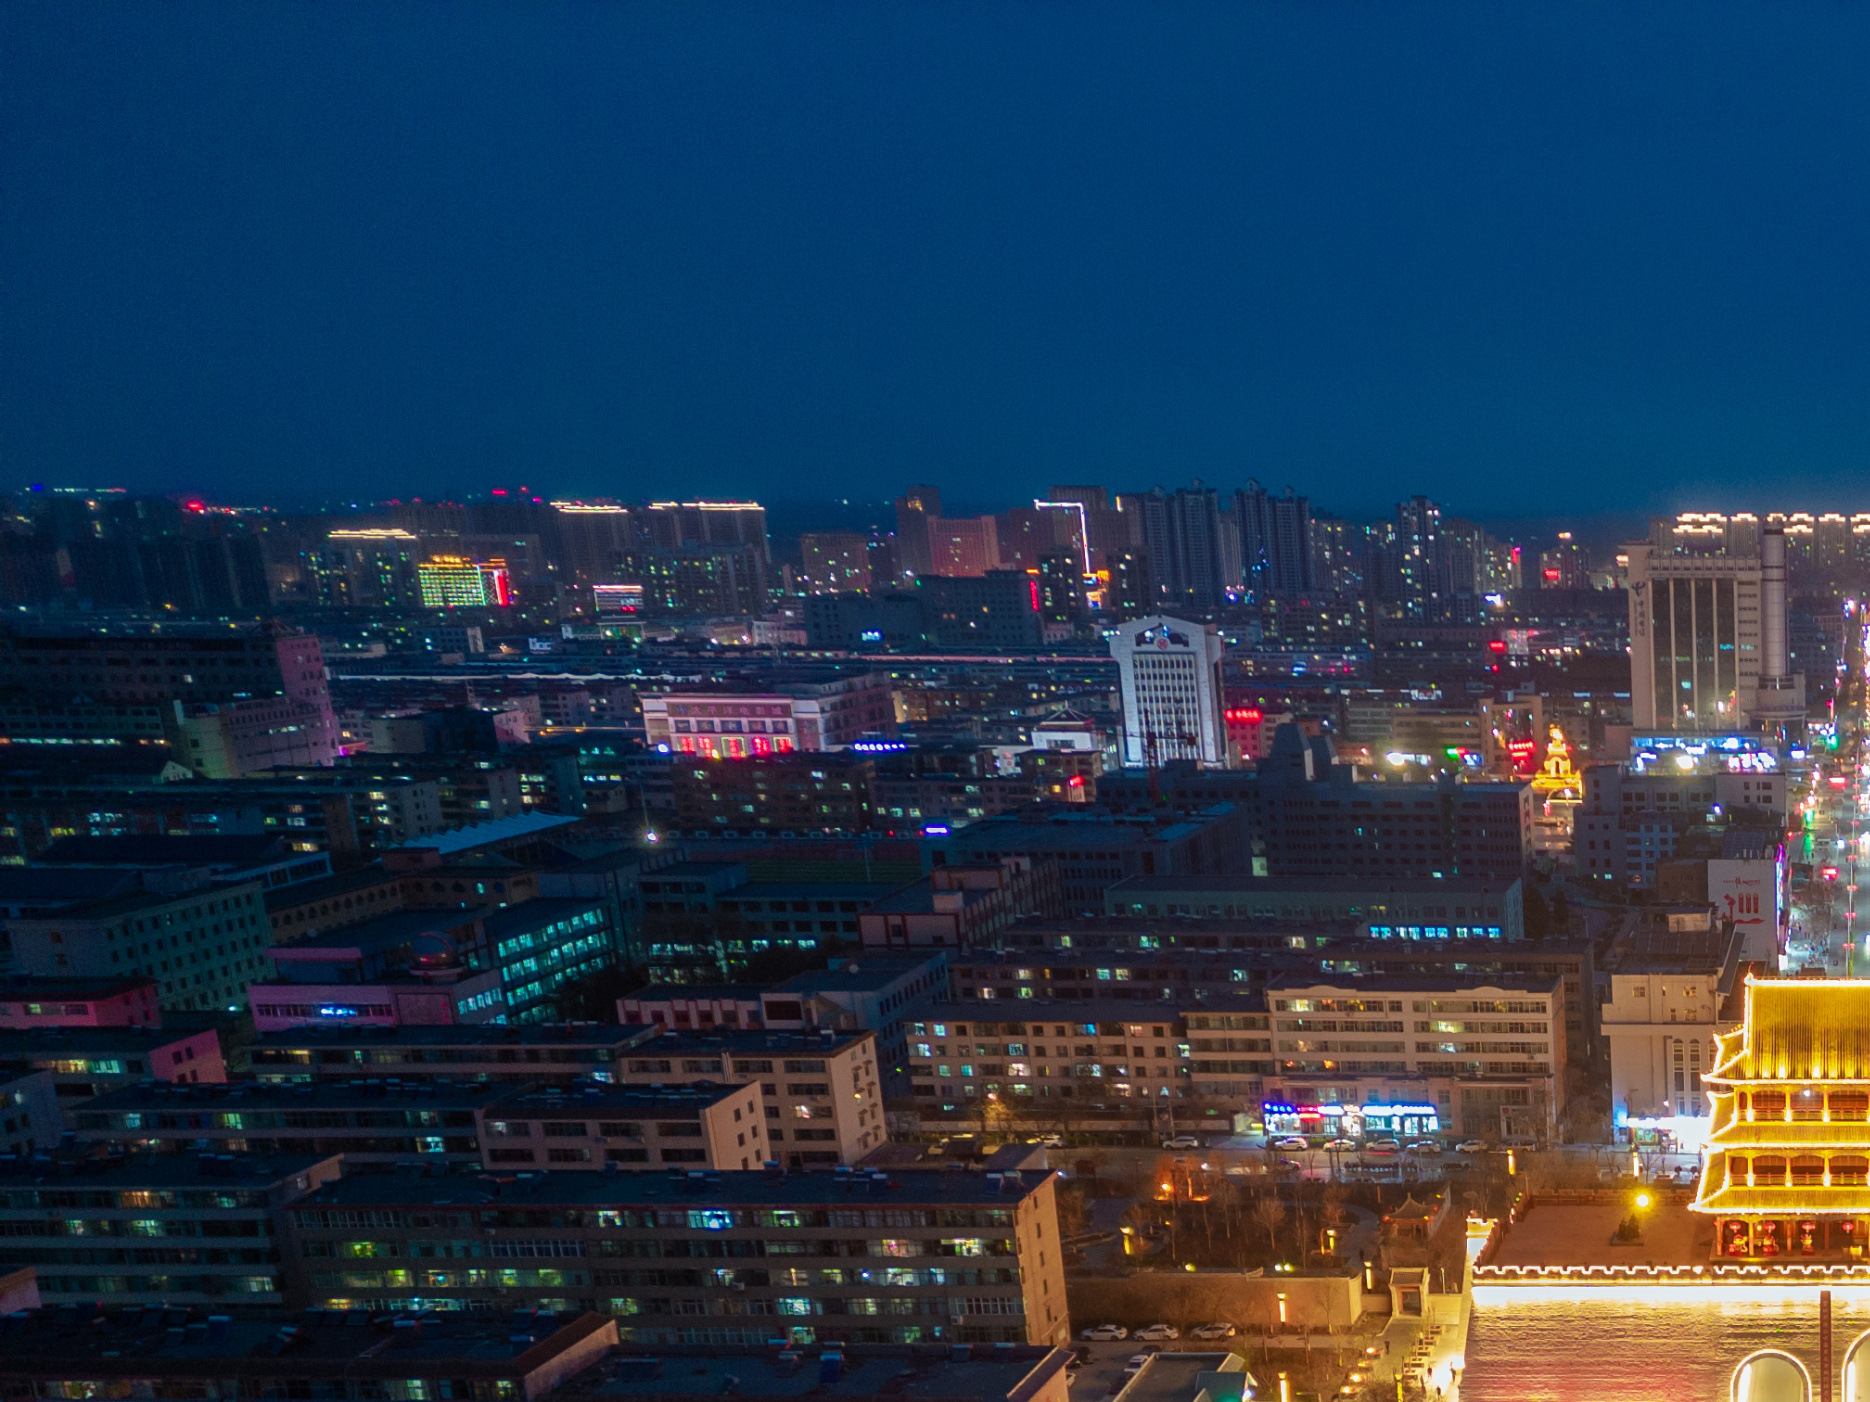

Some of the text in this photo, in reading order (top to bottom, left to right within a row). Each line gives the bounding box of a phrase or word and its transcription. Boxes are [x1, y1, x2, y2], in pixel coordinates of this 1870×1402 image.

[691, 705, 783, 716] 太平洋电影城
